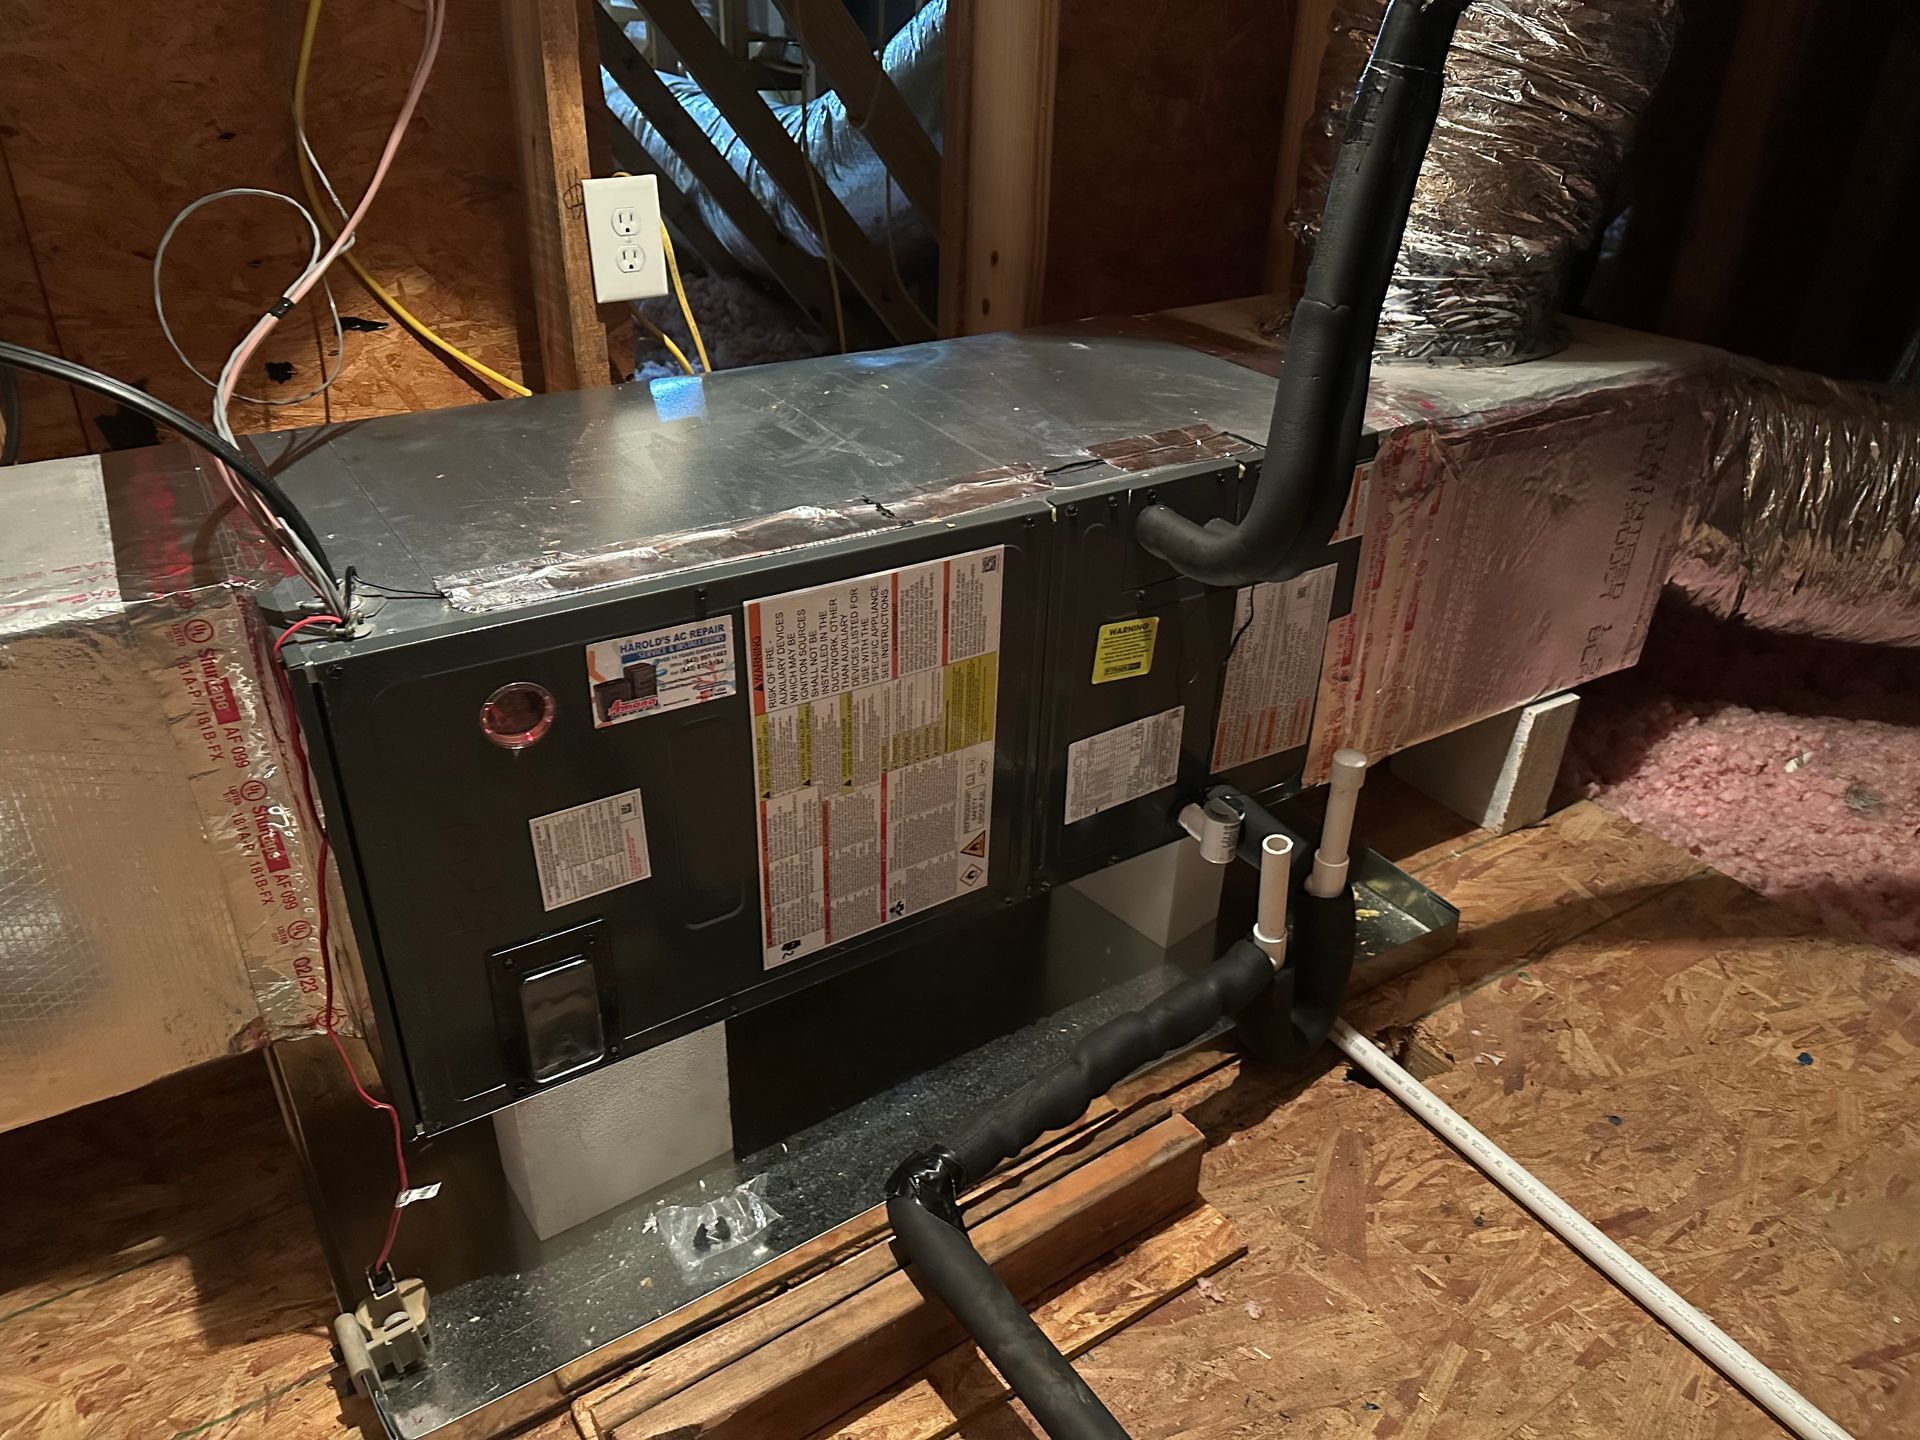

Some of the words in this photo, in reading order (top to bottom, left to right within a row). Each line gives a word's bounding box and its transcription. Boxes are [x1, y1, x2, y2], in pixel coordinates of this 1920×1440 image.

[849, 586, 858, 610] FOR
[870, 583, 879, 639] APPLIANCE
[818, 609, 828, 630] THE
[828, 597, 838, 633] OTHER
[849, 609, 859, 645] LISTED
[860, 616, 869, 637] THE
[172, 624, 186, 647] LISTED
[620, 637, 670, 653] HAROLD'S
[674, 631, 687, 642] AC
[689, 623, 725, 639] REPAIR
[774, 610, 786, 655] DEVICES
[786, 631, 796, 647] BE
[796, 606, 807, 657] SOURCES
[808, 628, 817, 644] BE
[819, 630, 828, 643] IN
[839, 612, 849, 663] AUXILIARY
[1107, 621, 1149, 636] WARNING
[751, 634, 762, 684] WARNING
[765, 645, 775, 669] FIRE
[787, 646, 797, 670] MAY
[808, 644, 818, 667] NOT
[860, 637, 869, 664] WITH
[870, 638, 879, 682] SPECIFIC
[766, 669, 775, 685] OF
[798, 657, 809, 701] IGNITION
[819, 642, 829, 695] INSTALLED
[840, 663, 849, 690] THAN
[850, 645, 859, 688] DEVICES
[860, 664, 869, 685] USE
[881, 659, 889, 680] SEE
[776, 655, 788, 706] AUXILIARY
[787, 669, 798, 704] WHICH
[809, 666, 819, 698] SHALL
[176, 656, 202, 698] 181A-P
[196, 712, 225, 762] 181B-FX
[766, 684, 776, 709] RISK
[223, 727, 243, 743] AF
[231, 746, 251, 769] 099
[232, 812, 255, 851] 181A-P
[249, 861, 275, 906] 181B-FX
[274, 874, 292, 887] AF
[281, 890, 298, 910] 099
